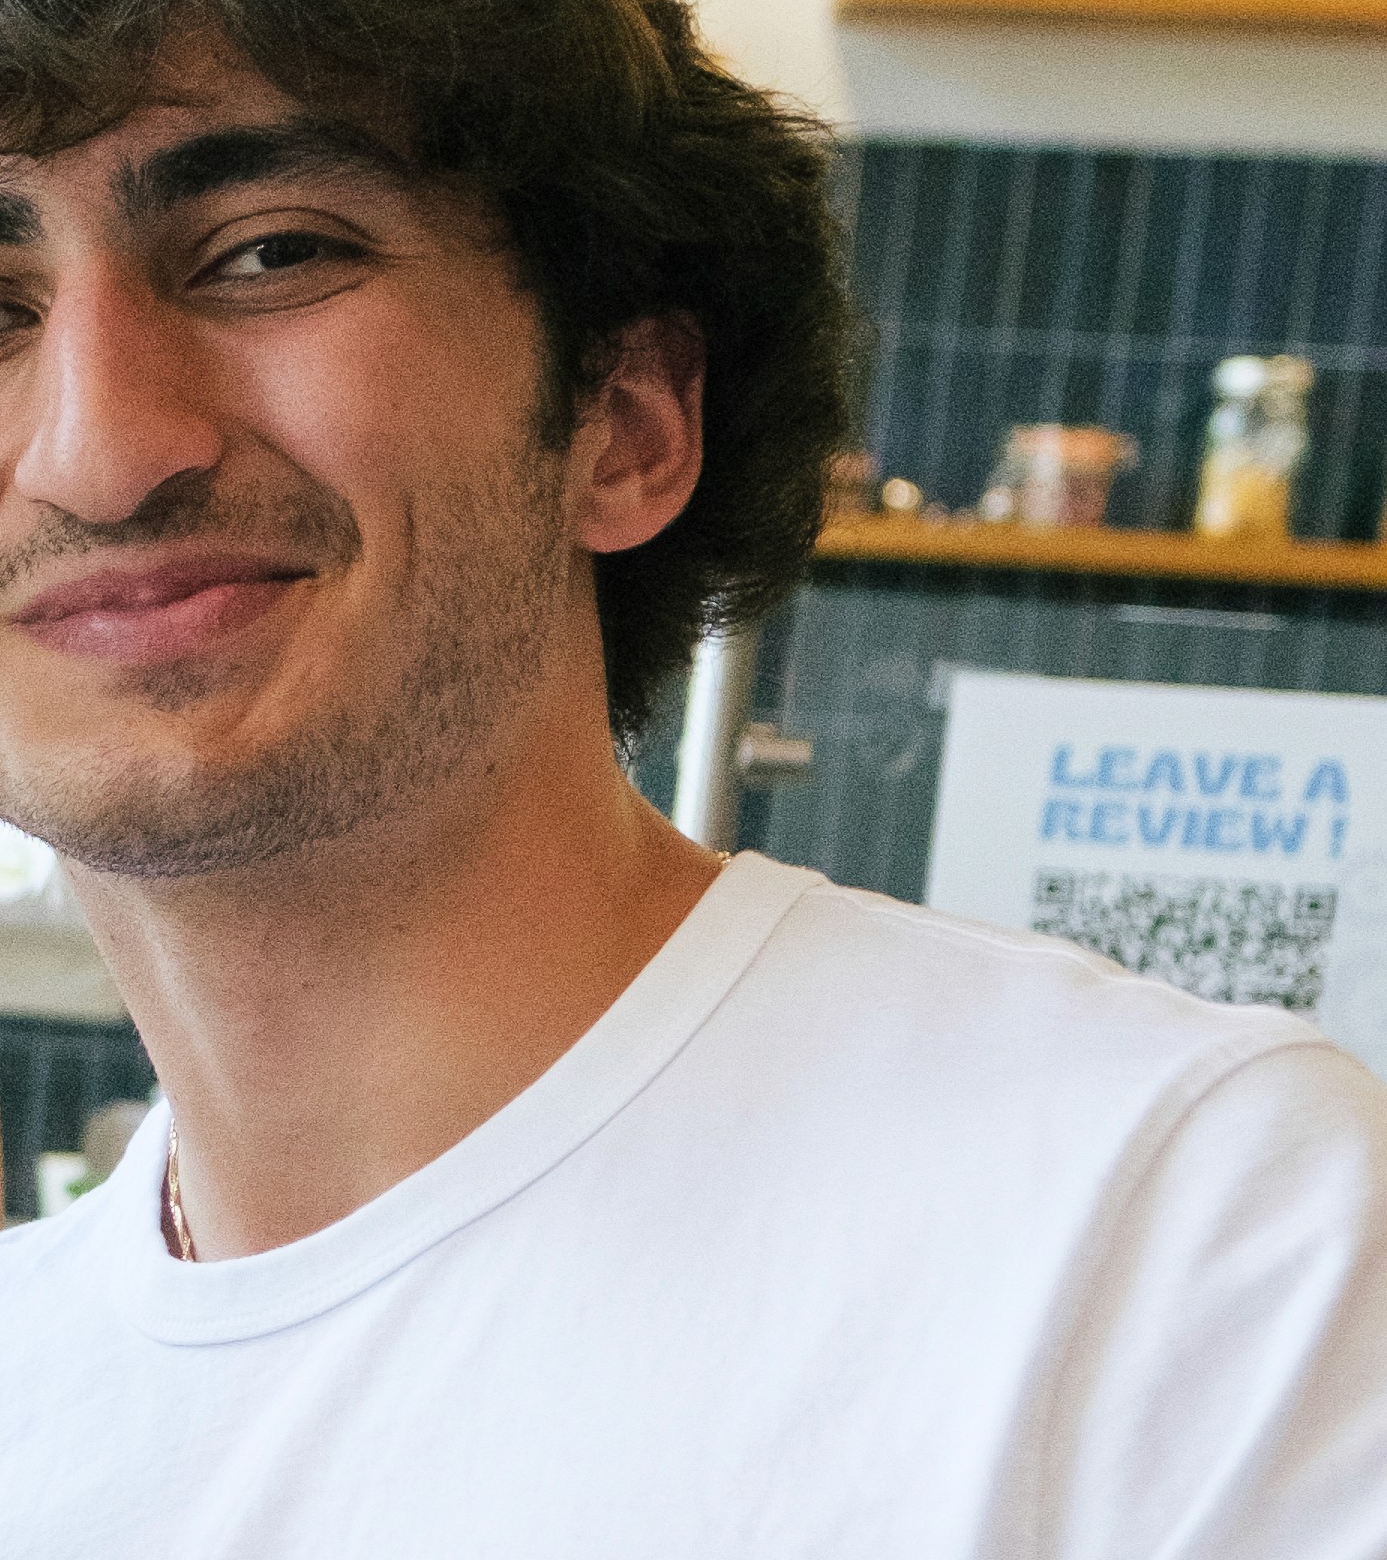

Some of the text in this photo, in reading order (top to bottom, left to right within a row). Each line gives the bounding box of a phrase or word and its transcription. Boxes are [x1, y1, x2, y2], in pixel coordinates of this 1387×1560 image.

[1049, 743, 1350, 806] LEAVE A
[1038, 795, 1309, 856] REVIEW
